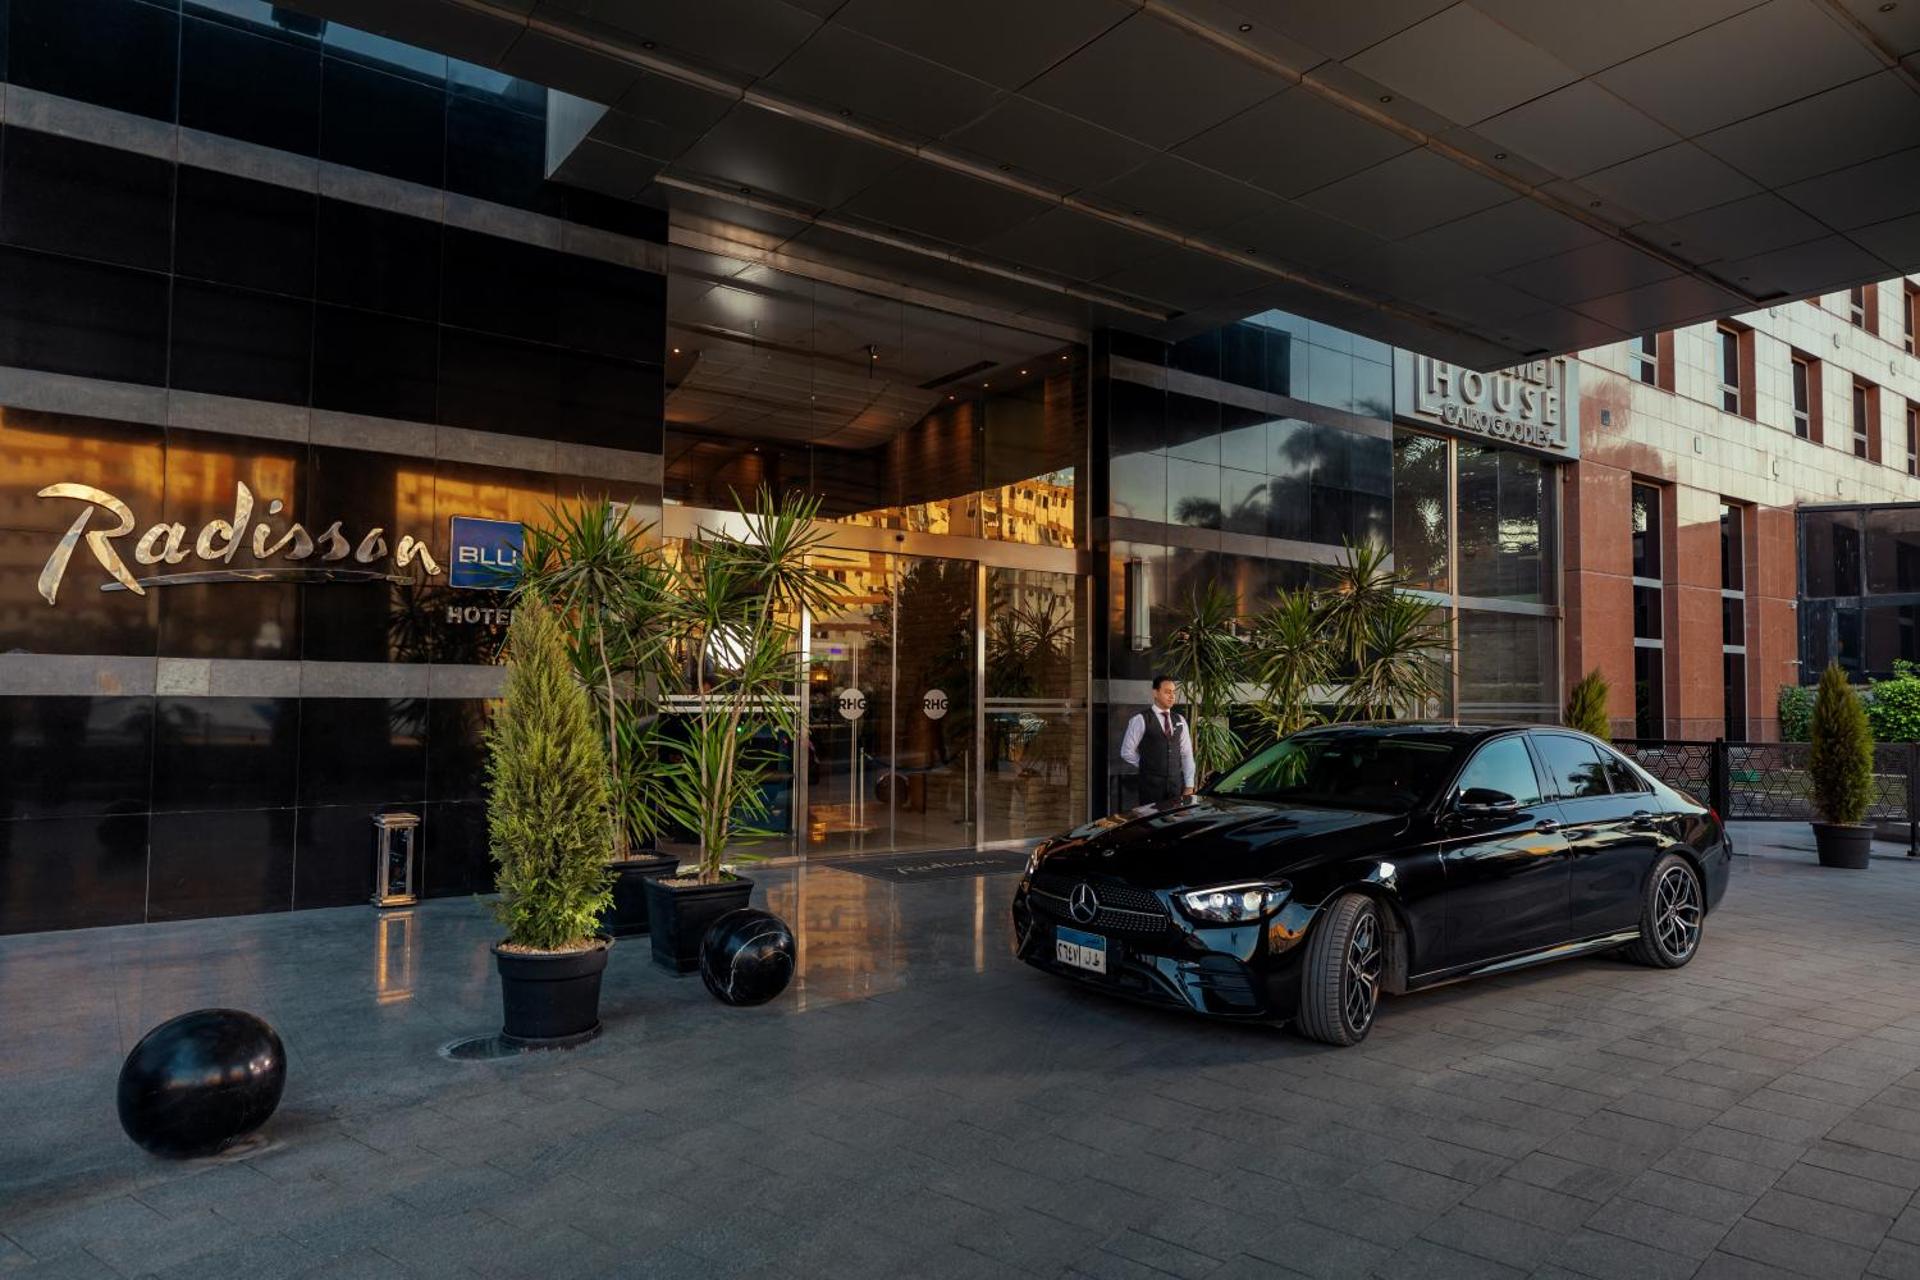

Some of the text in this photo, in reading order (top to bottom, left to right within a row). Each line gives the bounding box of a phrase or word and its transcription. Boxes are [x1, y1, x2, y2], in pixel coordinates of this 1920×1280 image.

[1428, 357, 1557, 426] HOUSE
[1442, 402, 1551, 449] CAIRO GOODIES
[37, 481, 517, 605] Radisson BLU
[839, 698, 867, 710] RHG
[923, 698, 949, 710] RHG
